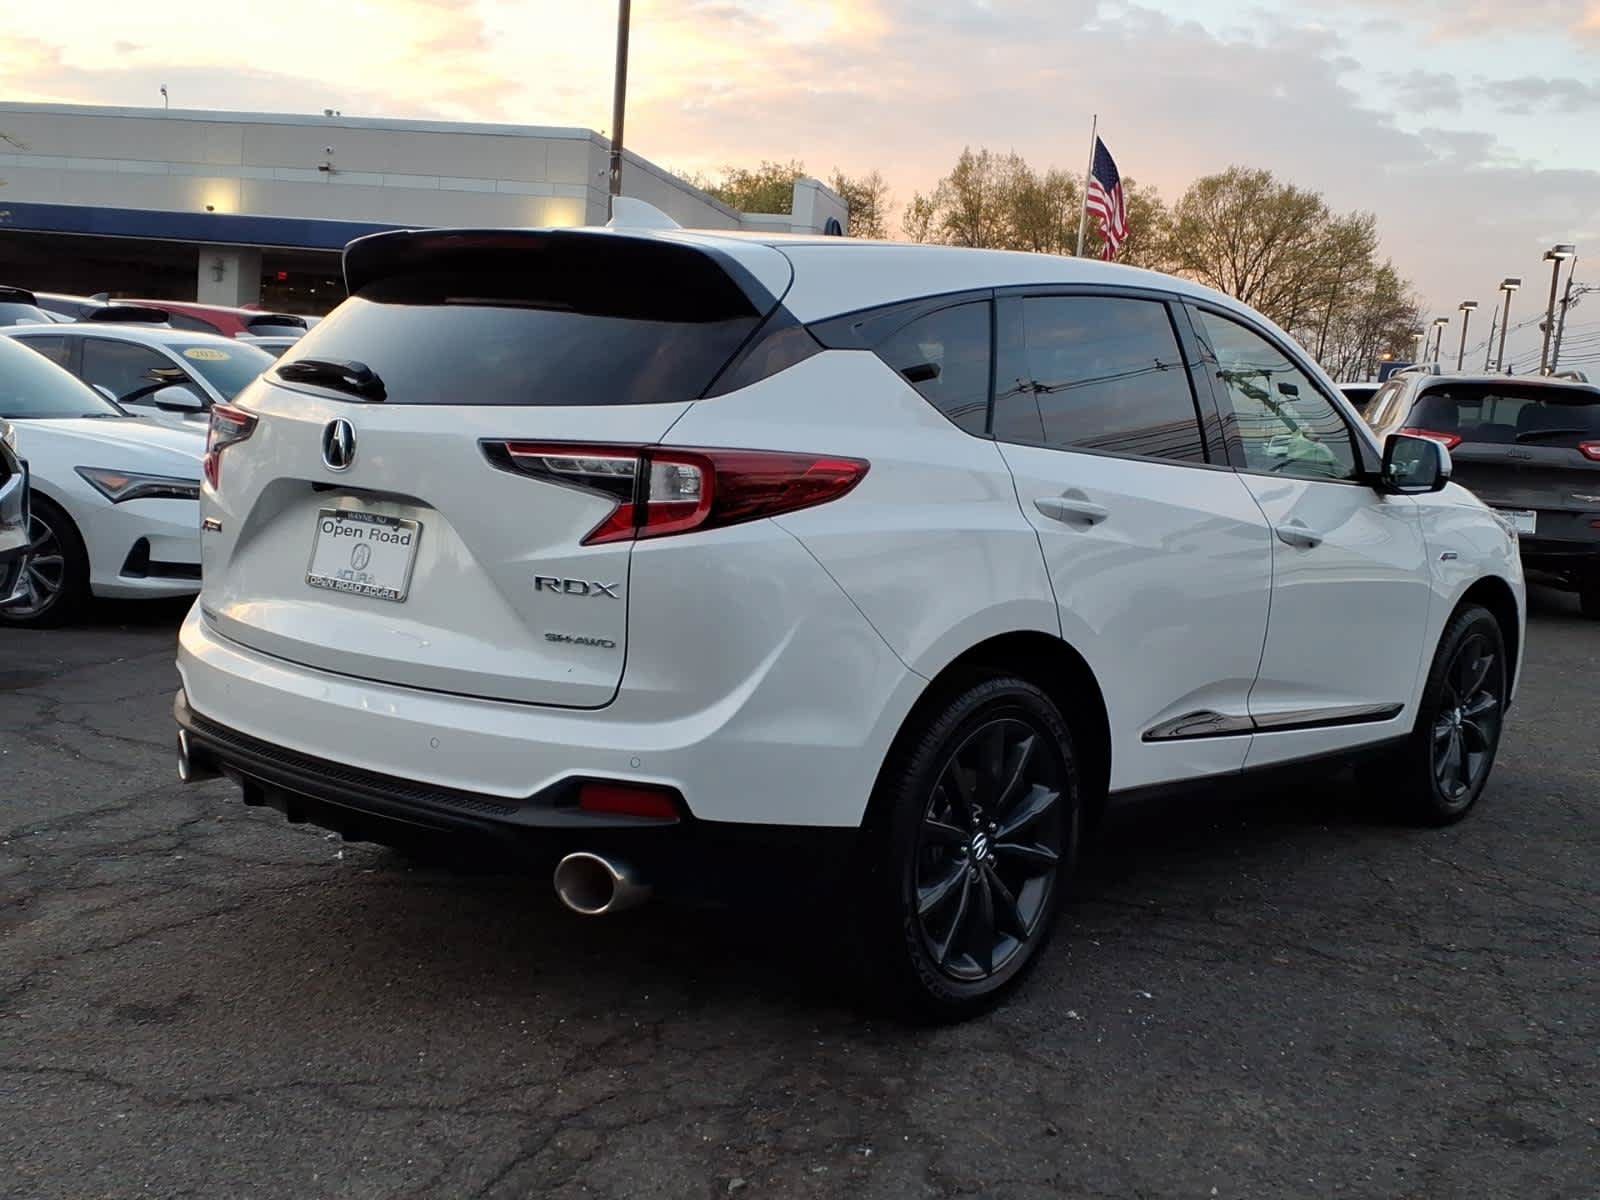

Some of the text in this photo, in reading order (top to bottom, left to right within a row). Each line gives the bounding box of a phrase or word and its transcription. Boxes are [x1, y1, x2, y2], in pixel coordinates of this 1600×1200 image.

[322, 520, 412, 546] Open Road
[309, 576, 397, 599] OPEN ROAD ACURA
[534, 575, 620, 599] RDX
